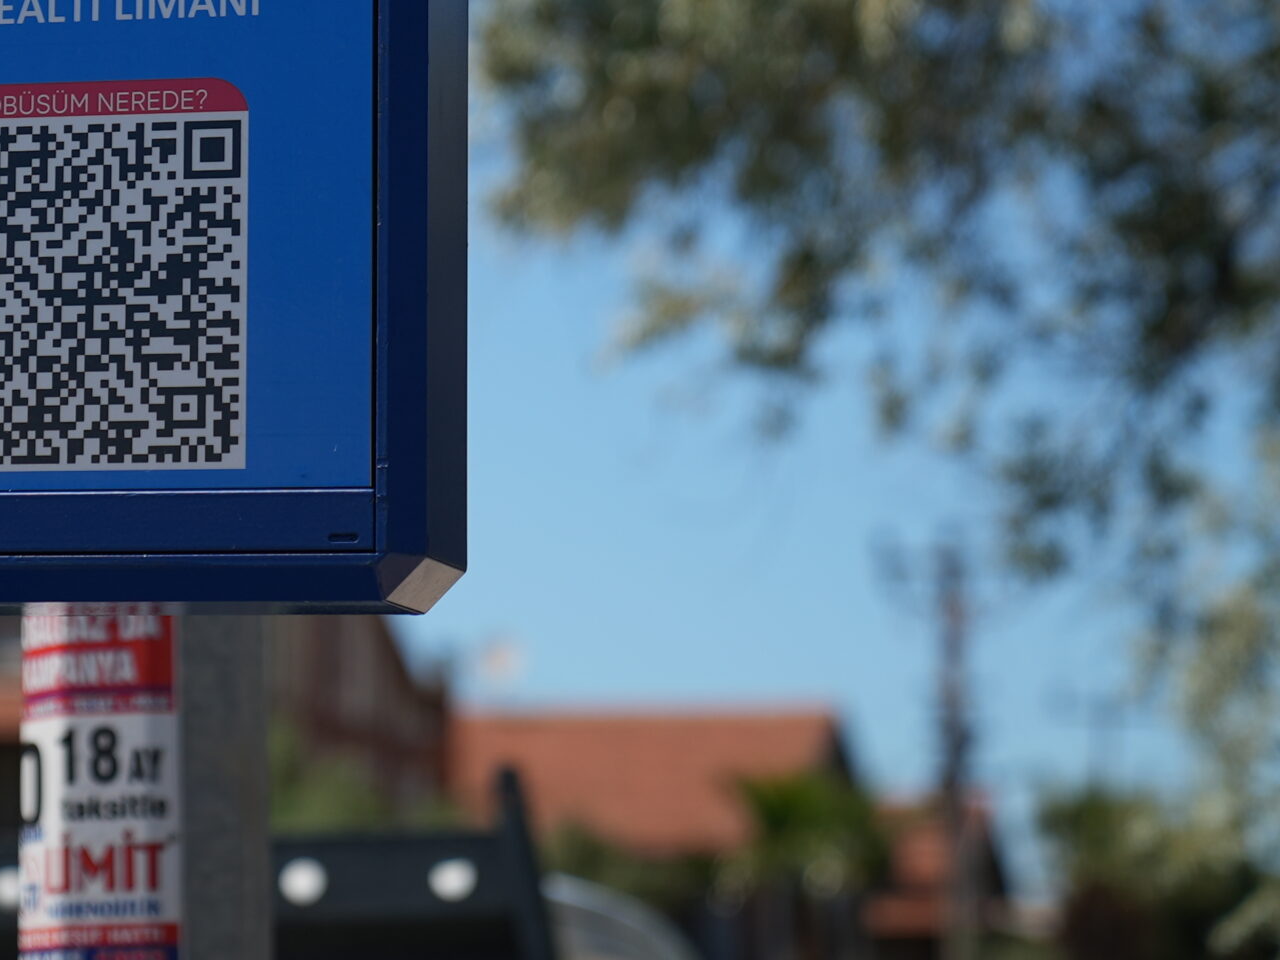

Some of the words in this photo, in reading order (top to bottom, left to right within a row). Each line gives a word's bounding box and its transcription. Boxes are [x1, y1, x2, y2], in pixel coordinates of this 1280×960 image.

[97, 88, 209, 113] NEREDE?
[58, 726, 120, 785] 18
[126, 747, 165, 785] AY
